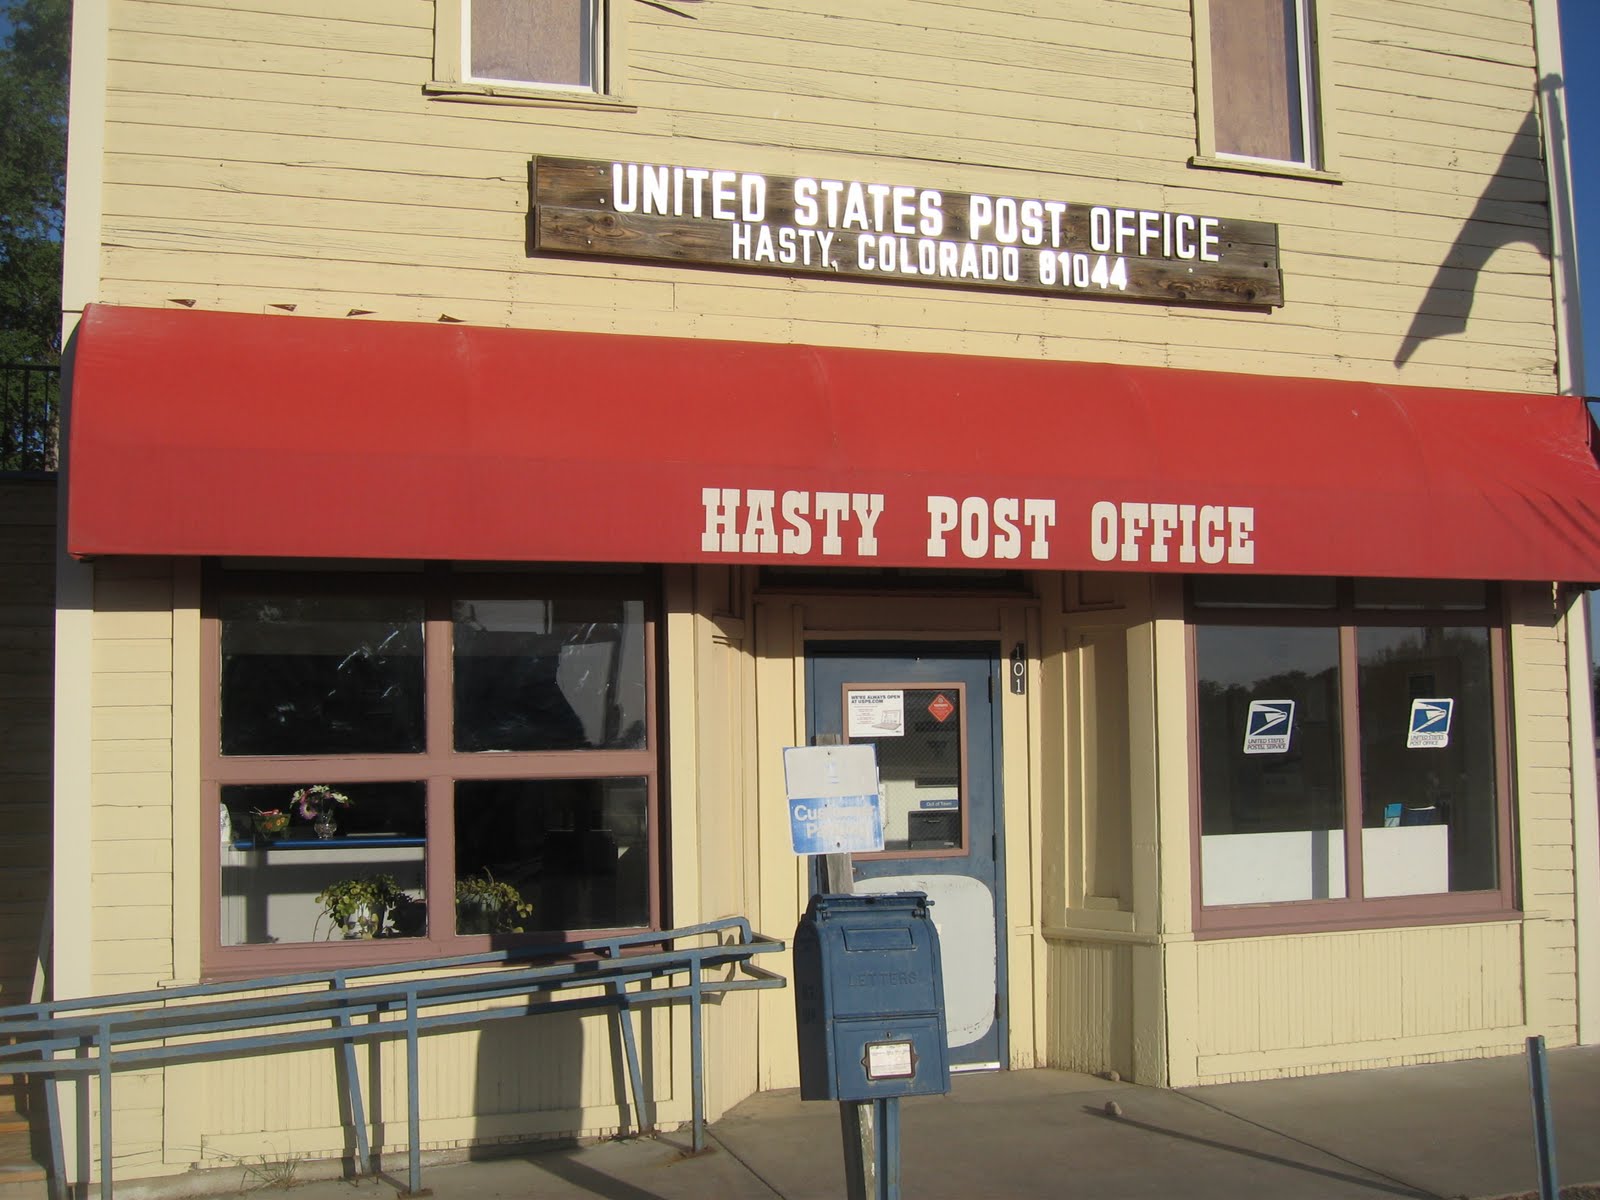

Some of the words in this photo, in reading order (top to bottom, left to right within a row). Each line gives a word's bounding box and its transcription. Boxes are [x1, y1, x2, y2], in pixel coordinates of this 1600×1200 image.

[612, 163, 766, 222] UNITED
[793, 177, 944, 238] STATES
[968, 194, 1067, 249] POST
[1089, 206, 1220, 263] OFFICE
[731, 222, 839, 272] HASTY,
[857, 233, 1020, 283] COLORADO
[1037, 249, 1128, 291] 81044
[701, 487, 885, 556] HASTY
[926, 495, 1056, 560] POST
[1091, 500, 1255, 564] OFFICE
[1013, 646, 1024, 693] 101
[848, 972, 918, 987] LETTERS
